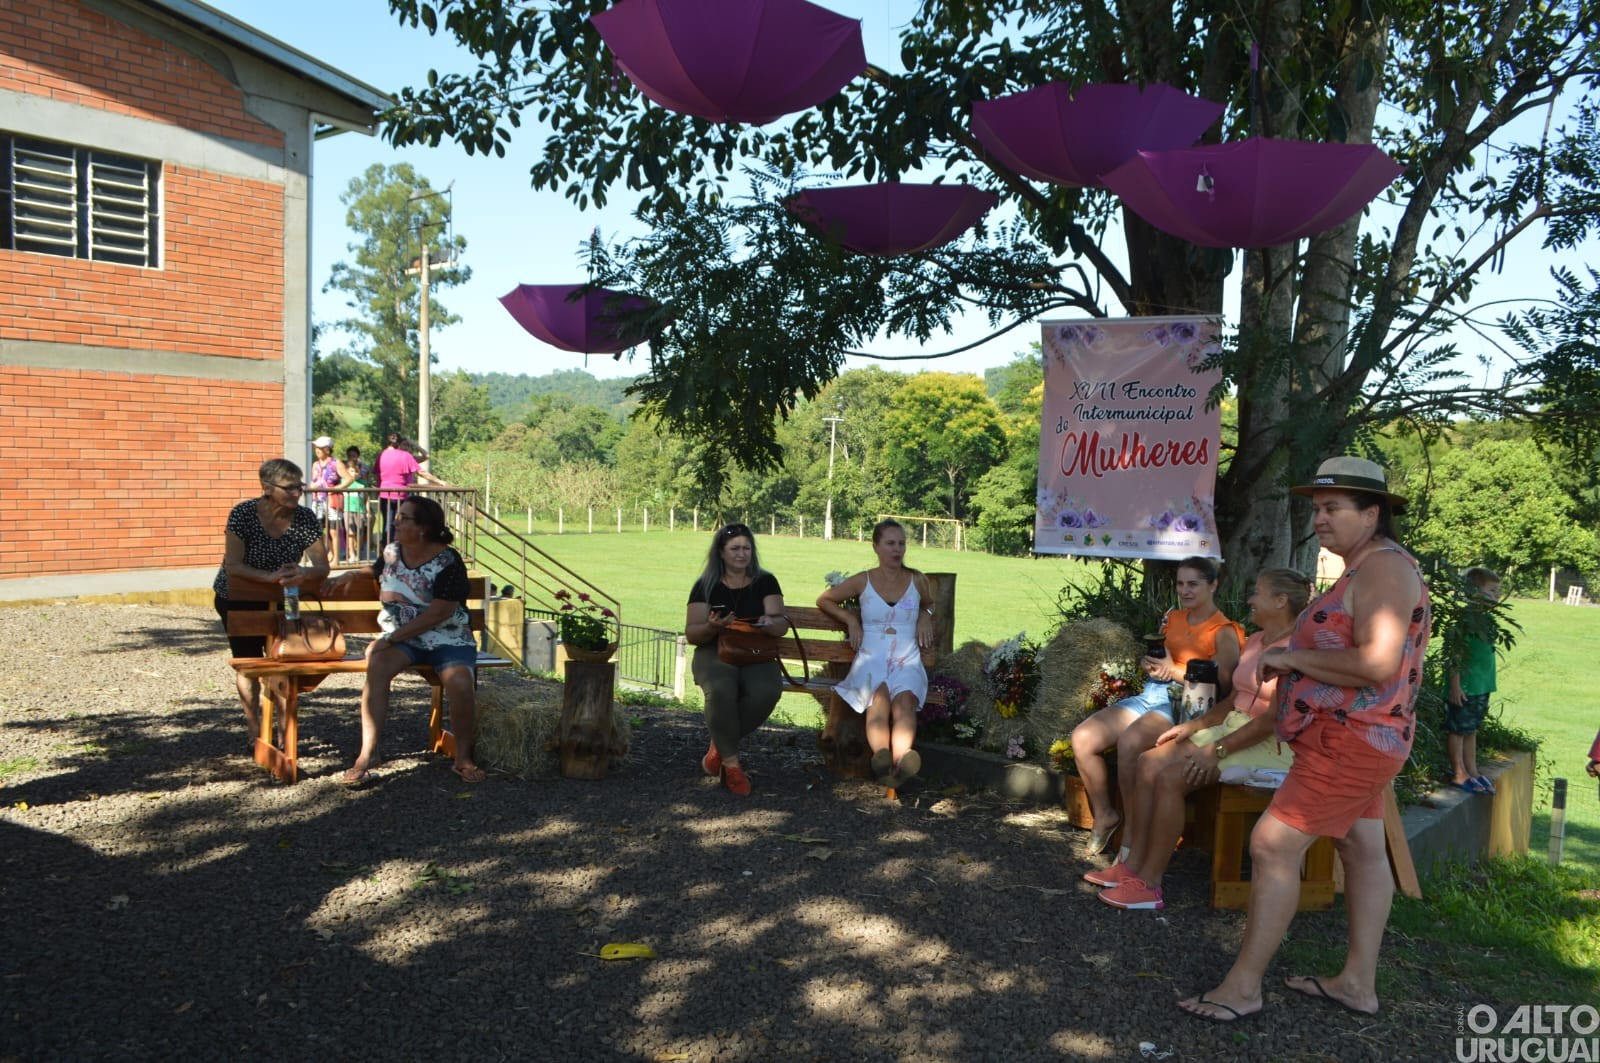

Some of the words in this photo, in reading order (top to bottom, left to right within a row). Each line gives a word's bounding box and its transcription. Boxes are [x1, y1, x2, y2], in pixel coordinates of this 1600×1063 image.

[1069, 381, 1115, 400] XVII
[1122, 381, 1197, 399] Encontro
[1073, 403, 1193, 424] Intermunicipal
[1056, 416, 1068, 433] de
[1061, 430, 1208, 477] Mulheres
